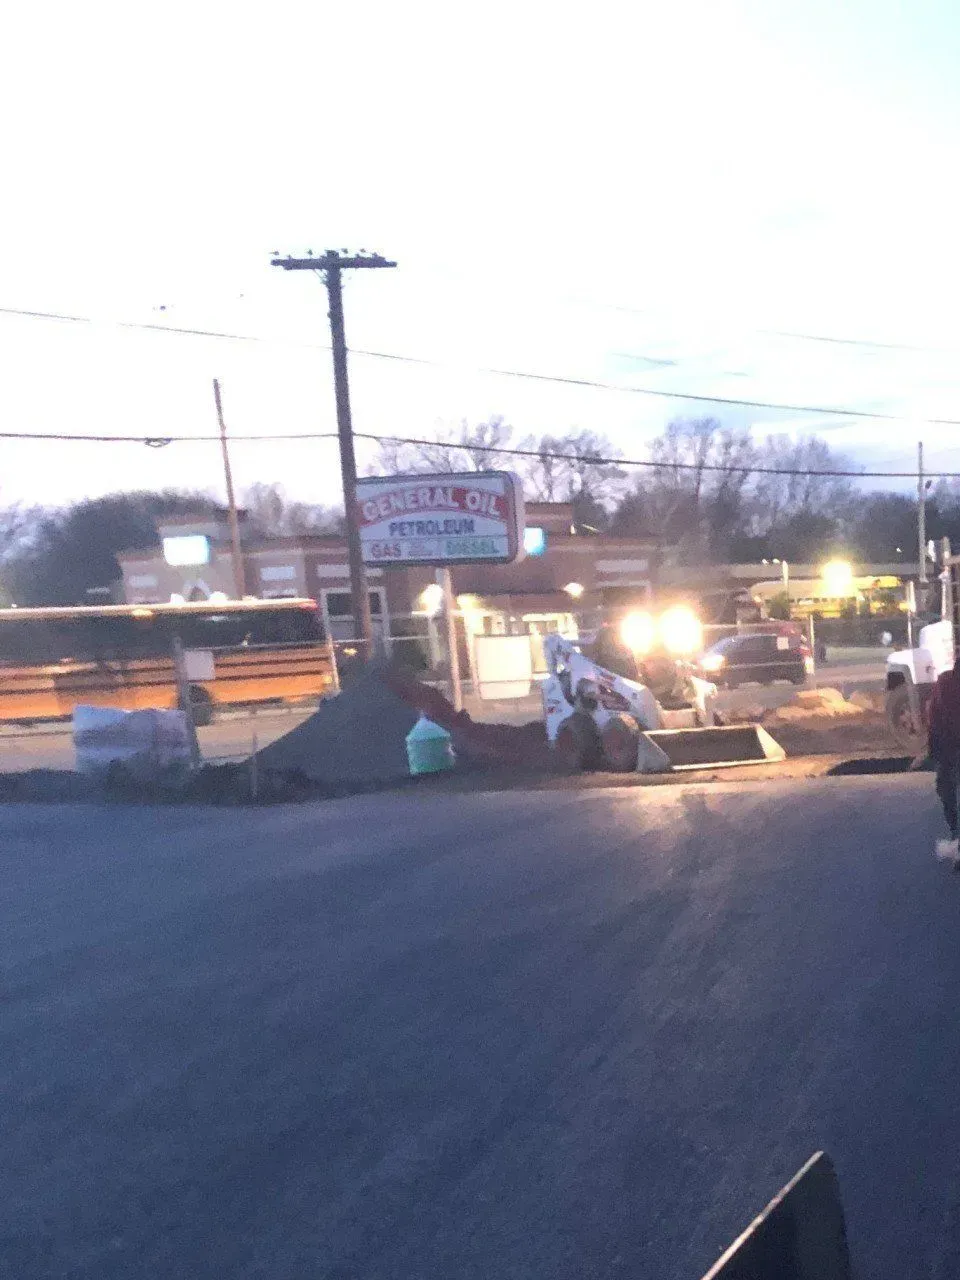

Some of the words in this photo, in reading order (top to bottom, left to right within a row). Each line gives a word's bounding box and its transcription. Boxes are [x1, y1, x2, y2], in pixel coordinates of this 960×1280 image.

[363, 487, 459, 520] GENERAL
[466, 491, 500, 515] OIL
[389, 519, 475, 536] PETROLEUM
[371, 542, 401, 558] GAS
[446, 538, 500, 555] DIESEL
